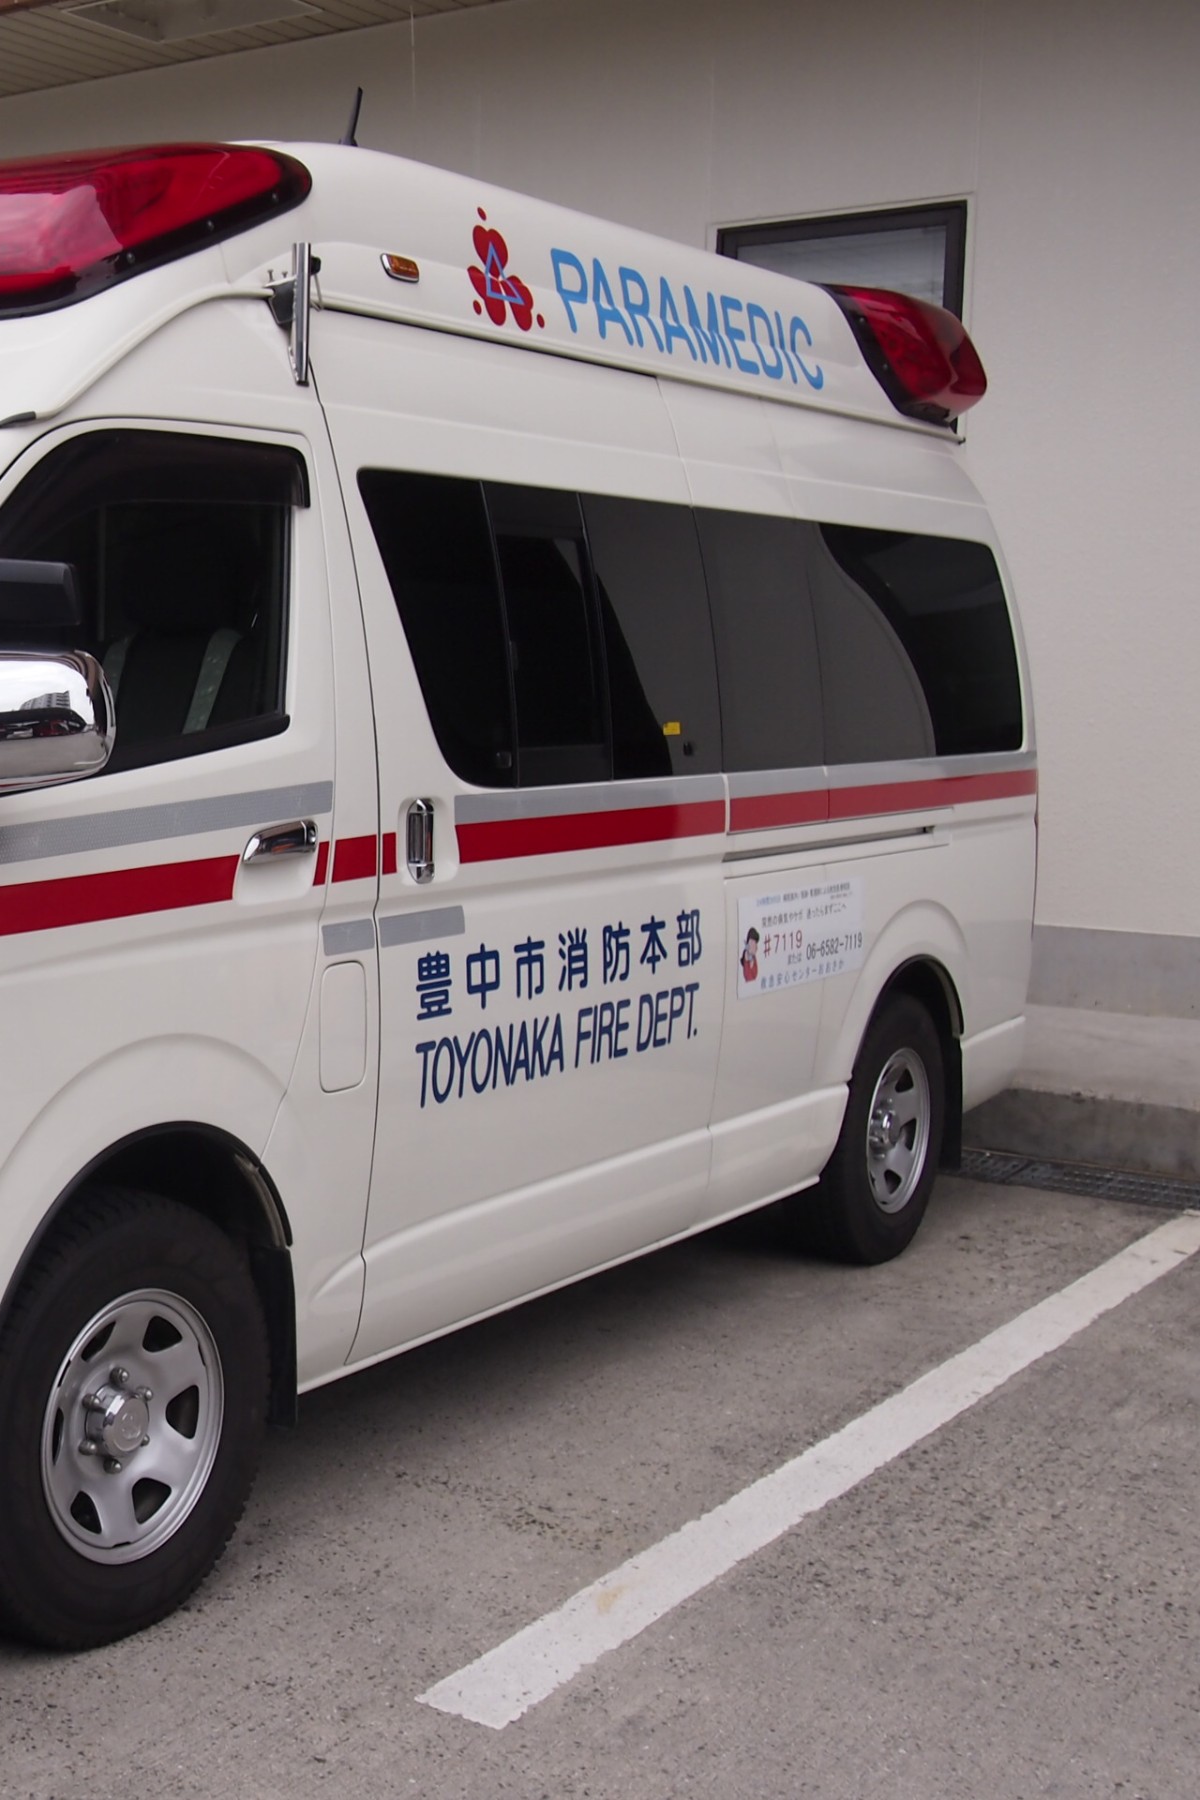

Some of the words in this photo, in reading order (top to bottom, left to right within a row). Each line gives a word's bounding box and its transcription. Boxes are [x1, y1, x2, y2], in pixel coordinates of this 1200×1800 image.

[550, 247, 824, 390] PARAMEDIC
[416, 908, 702, 1021] 豊中市消防本部
[763, 930, 803, 959] #7119
[806, 932, 863, 960] 06-6582-7119
[415, 1012, 565, 1109] TOYONAKA
[574, 998, 631, 1069] FIRE
[636, 982, 700, 1052] DEPT.
